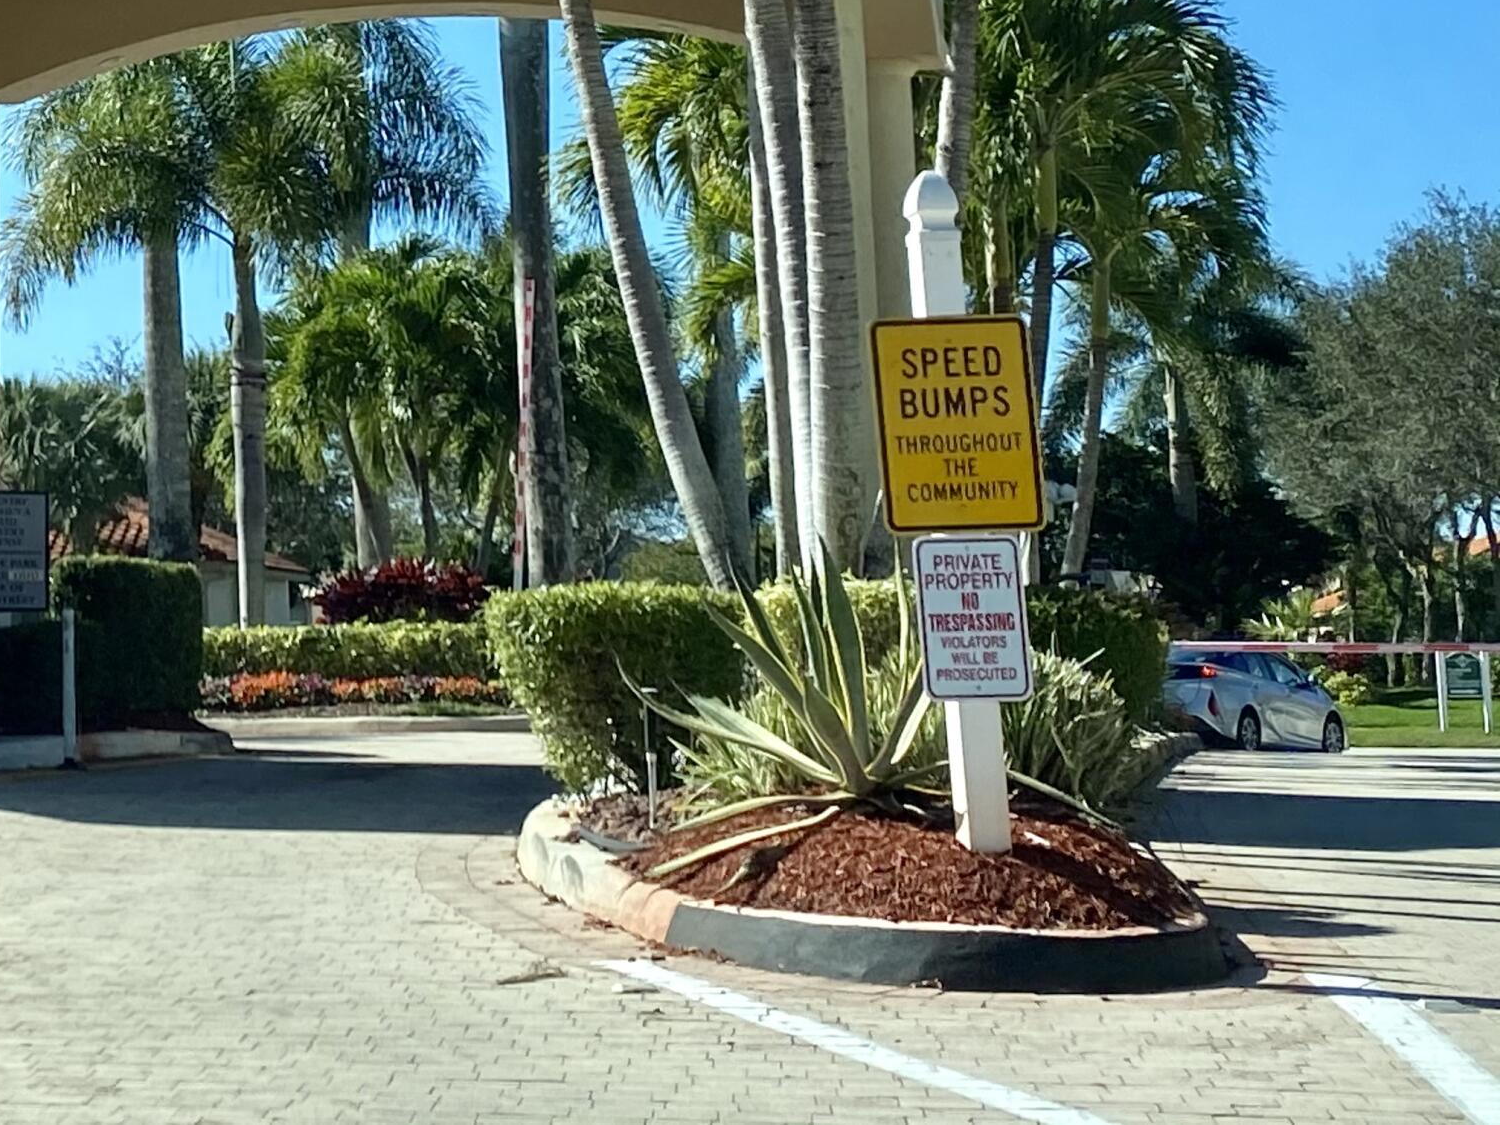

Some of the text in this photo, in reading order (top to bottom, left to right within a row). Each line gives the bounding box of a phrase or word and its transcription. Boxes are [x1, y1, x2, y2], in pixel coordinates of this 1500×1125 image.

[901, 346, 1001, 379] SPEED
[900, 386, 1011, 419] BUMPS
[895, 432, 1022, 455] THROUGHOUT
[943, 458, 979, 477] THE
[907, 481, 1019, 503] COMMUNITY
[933, 553, 1002, 571] PRIVATE
[924, 572, 1014, 590] PROPERTY
[961, 592, 979, 610] NO
[928, 613, 1015, 632] TRESPASSING
[941, 636, 1007, 649] VIOLATORS
[951, 651, 999, 665] WILL BE
[936, 667, 1017, 682] PROSECUTED
